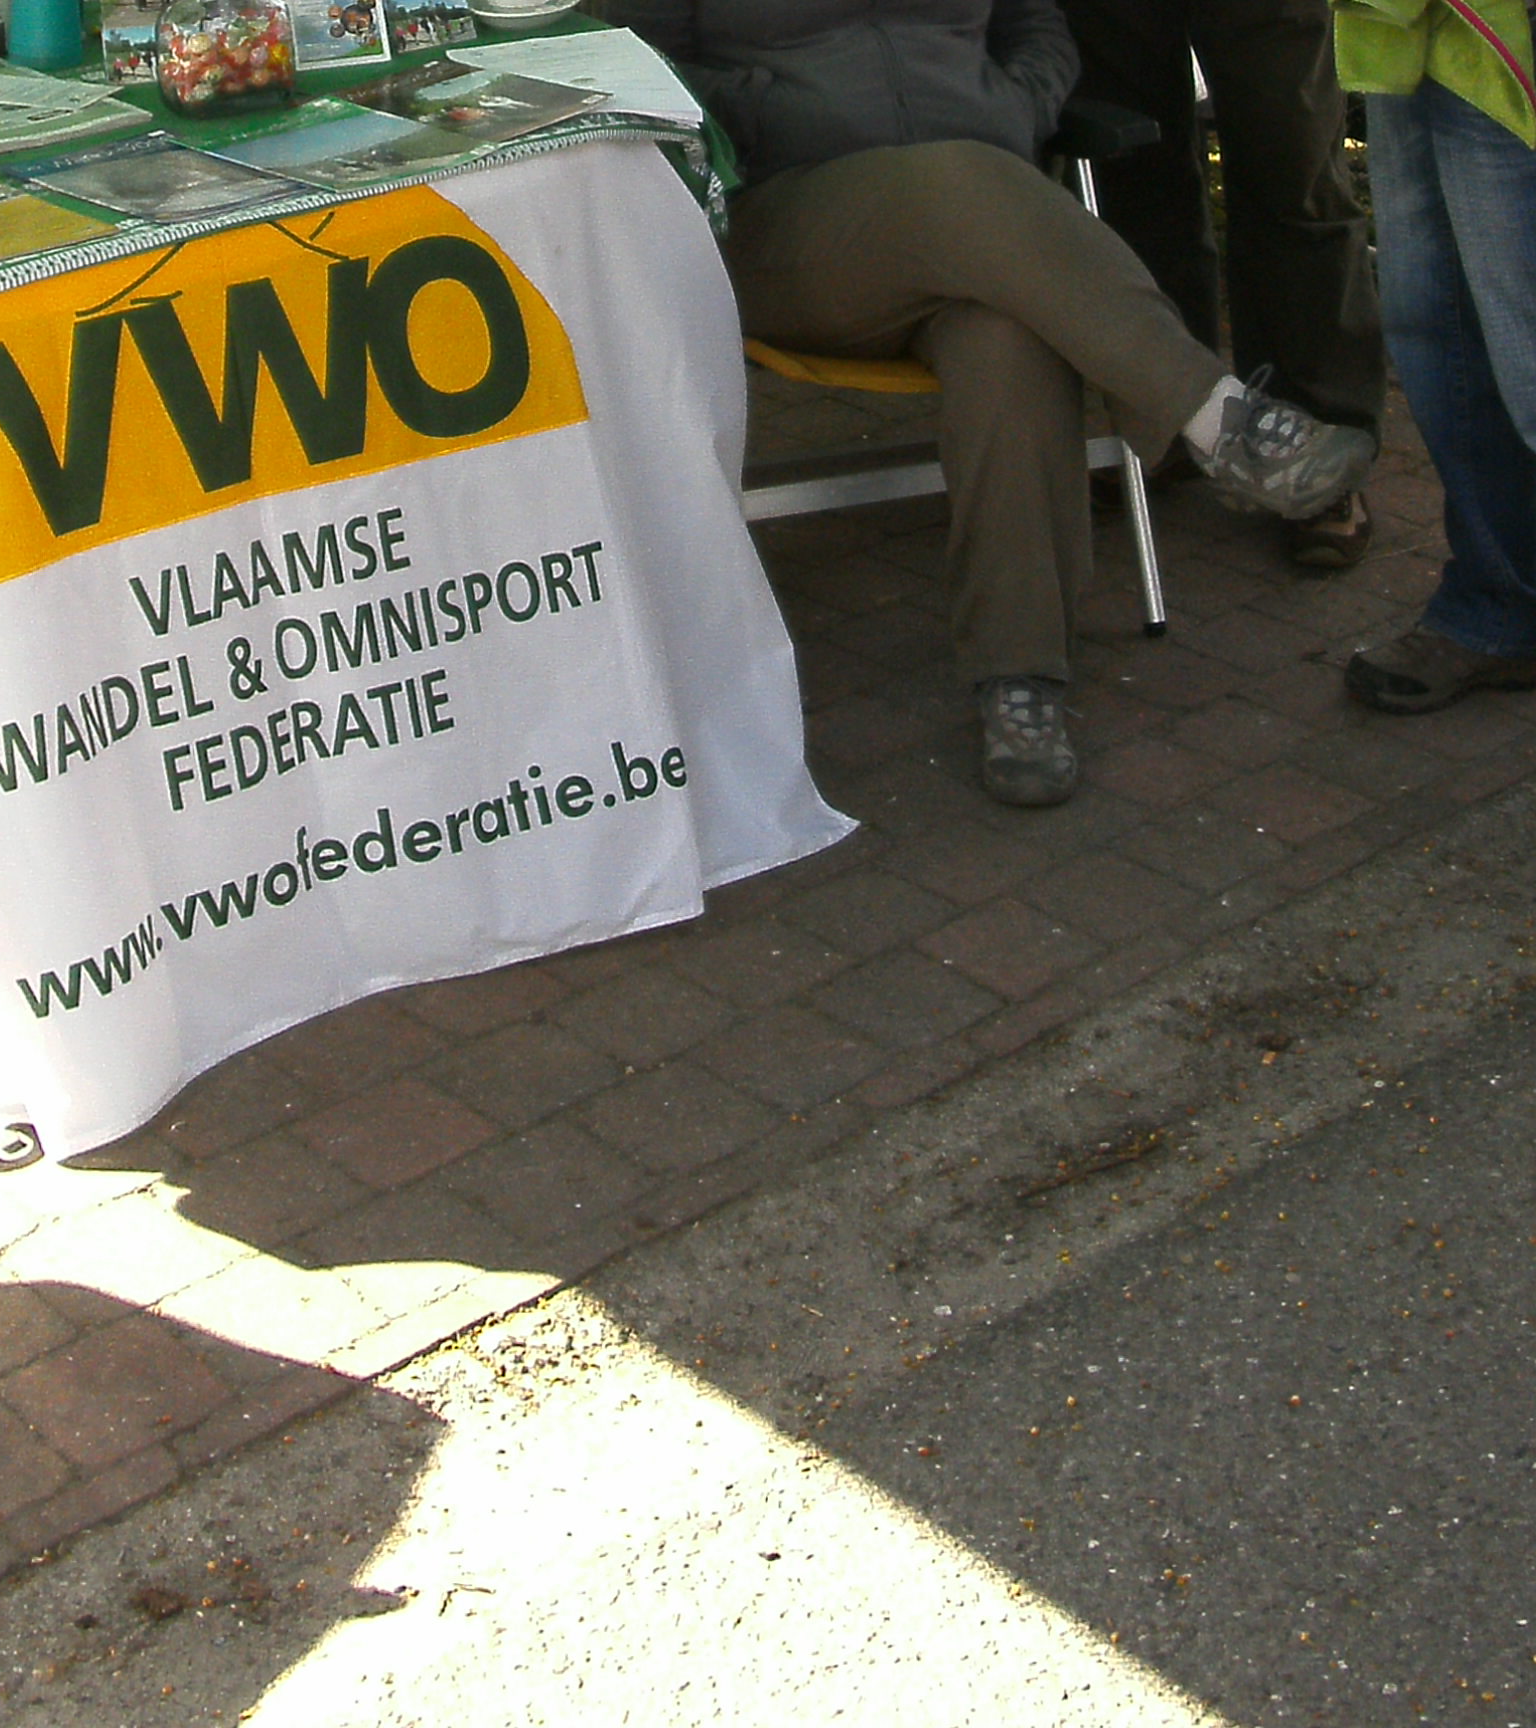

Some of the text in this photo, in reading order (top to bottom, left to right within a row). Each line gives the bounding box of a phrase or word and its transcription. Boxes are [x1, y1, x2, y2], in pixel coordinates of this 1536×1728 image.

[128, 509, 411, 637] VLAAMSE
[228, 635, 268, 702] &
[274, 541, 604, 680] OMNISPORT
[162, 668, 455, 812] FEDERATIE
[15, 740, 687, 1020] www.vwofederatie.be
